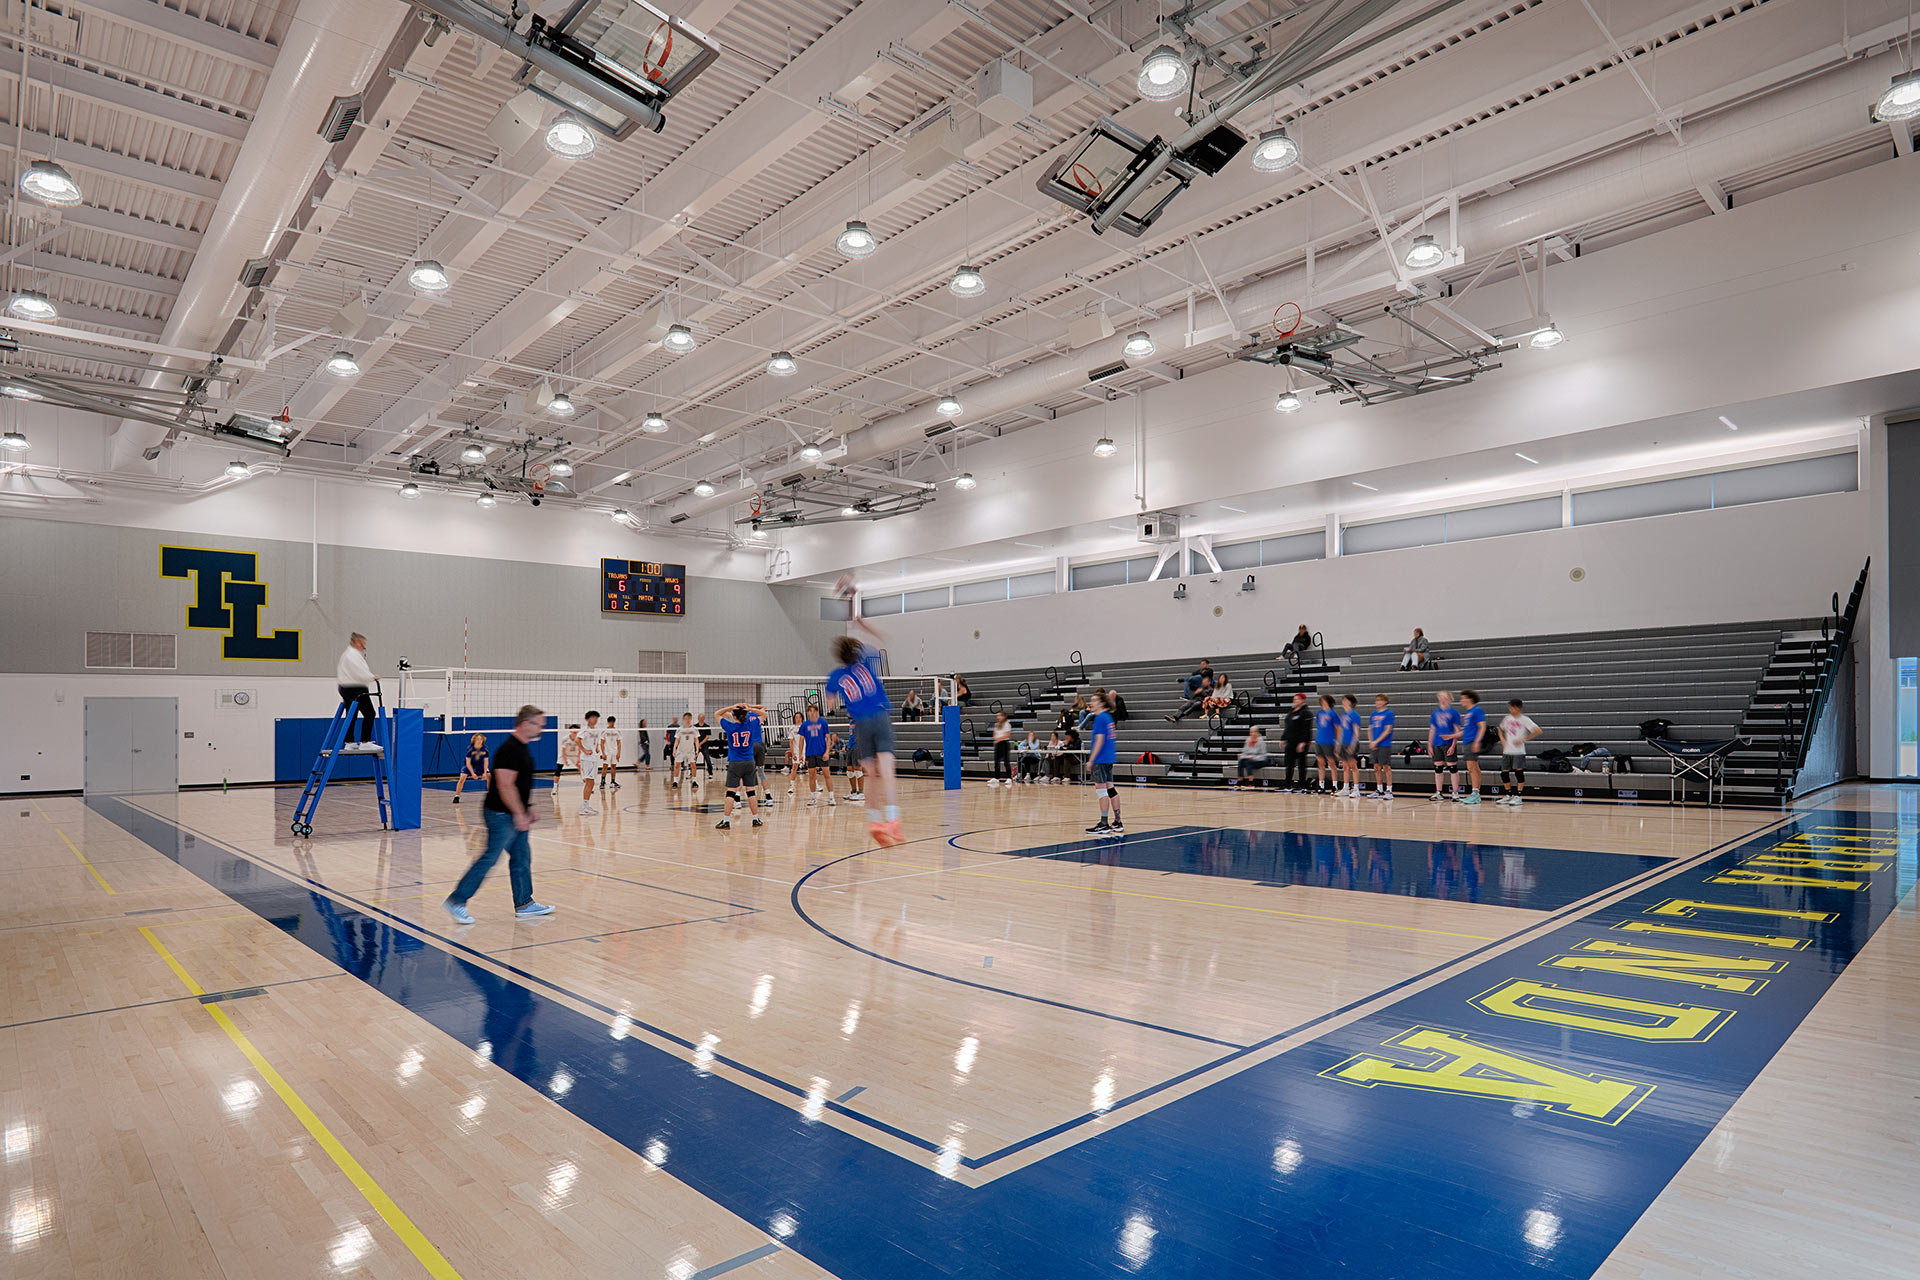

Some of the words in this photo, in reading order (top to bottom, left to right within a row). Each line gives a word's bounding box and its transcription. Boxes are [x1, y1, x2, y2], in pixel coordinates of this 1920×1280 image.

[641, 563, 660, 574] 1:00
[619, 580, 626, 592] 6
[674, 584, 681, 595] 9
[159, 544, 303, 662] TL
[611, 600, 618, 610] 0
[623, 601, 630, 610] 2
[660, 603, 667, 613] 2
[674, 604, 681, 614] 0
[731, 730, 751, 748] 17
[1317, 897, 1840, 1127] LINDA
